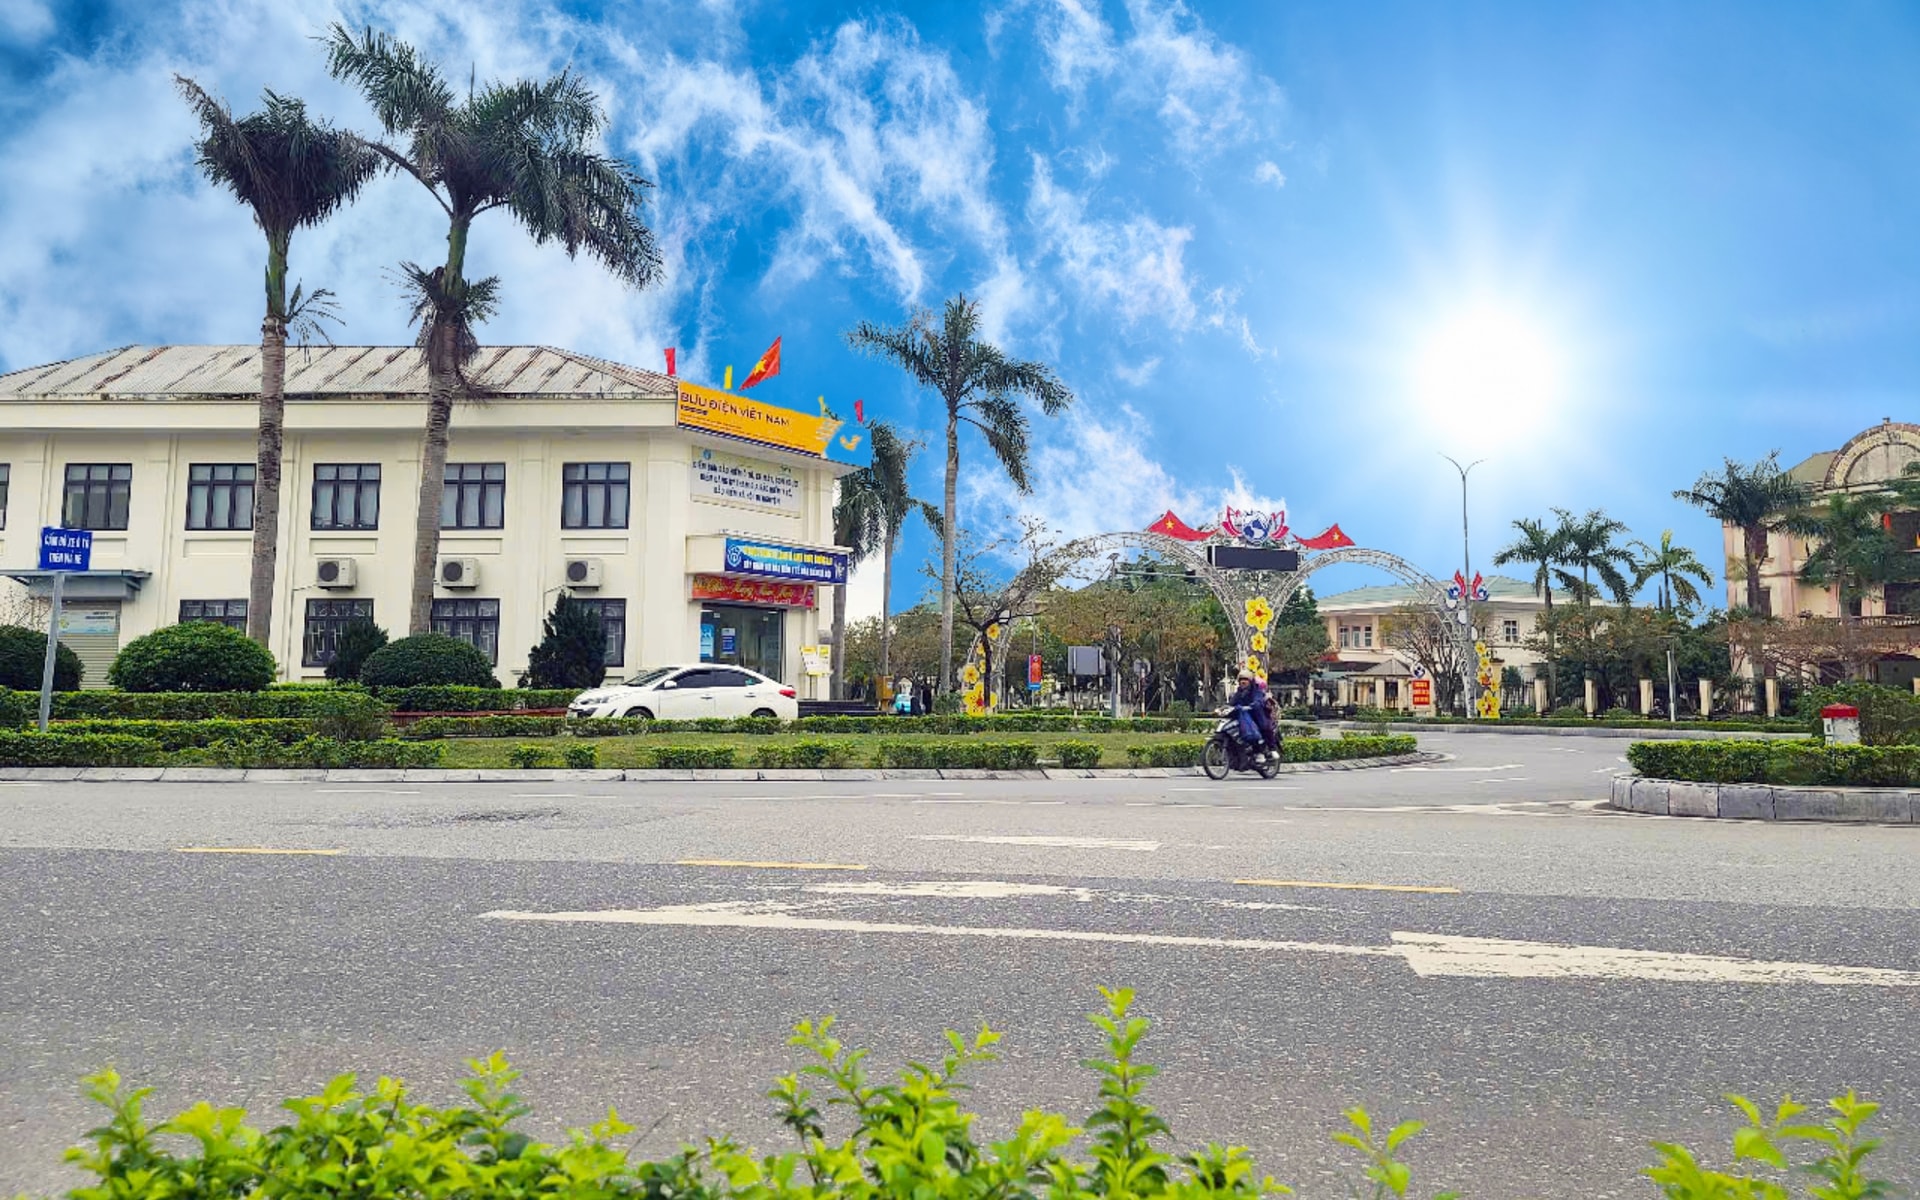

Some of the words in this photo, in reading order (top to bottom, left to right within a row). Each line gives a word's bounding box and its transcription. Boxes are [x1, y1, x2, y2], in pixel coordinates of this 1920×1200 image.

[709, 399, 738, 415] ĐIỆN
[740, 407, 762, 421] VIỆT
[765, 414, 790, 427] NAM
